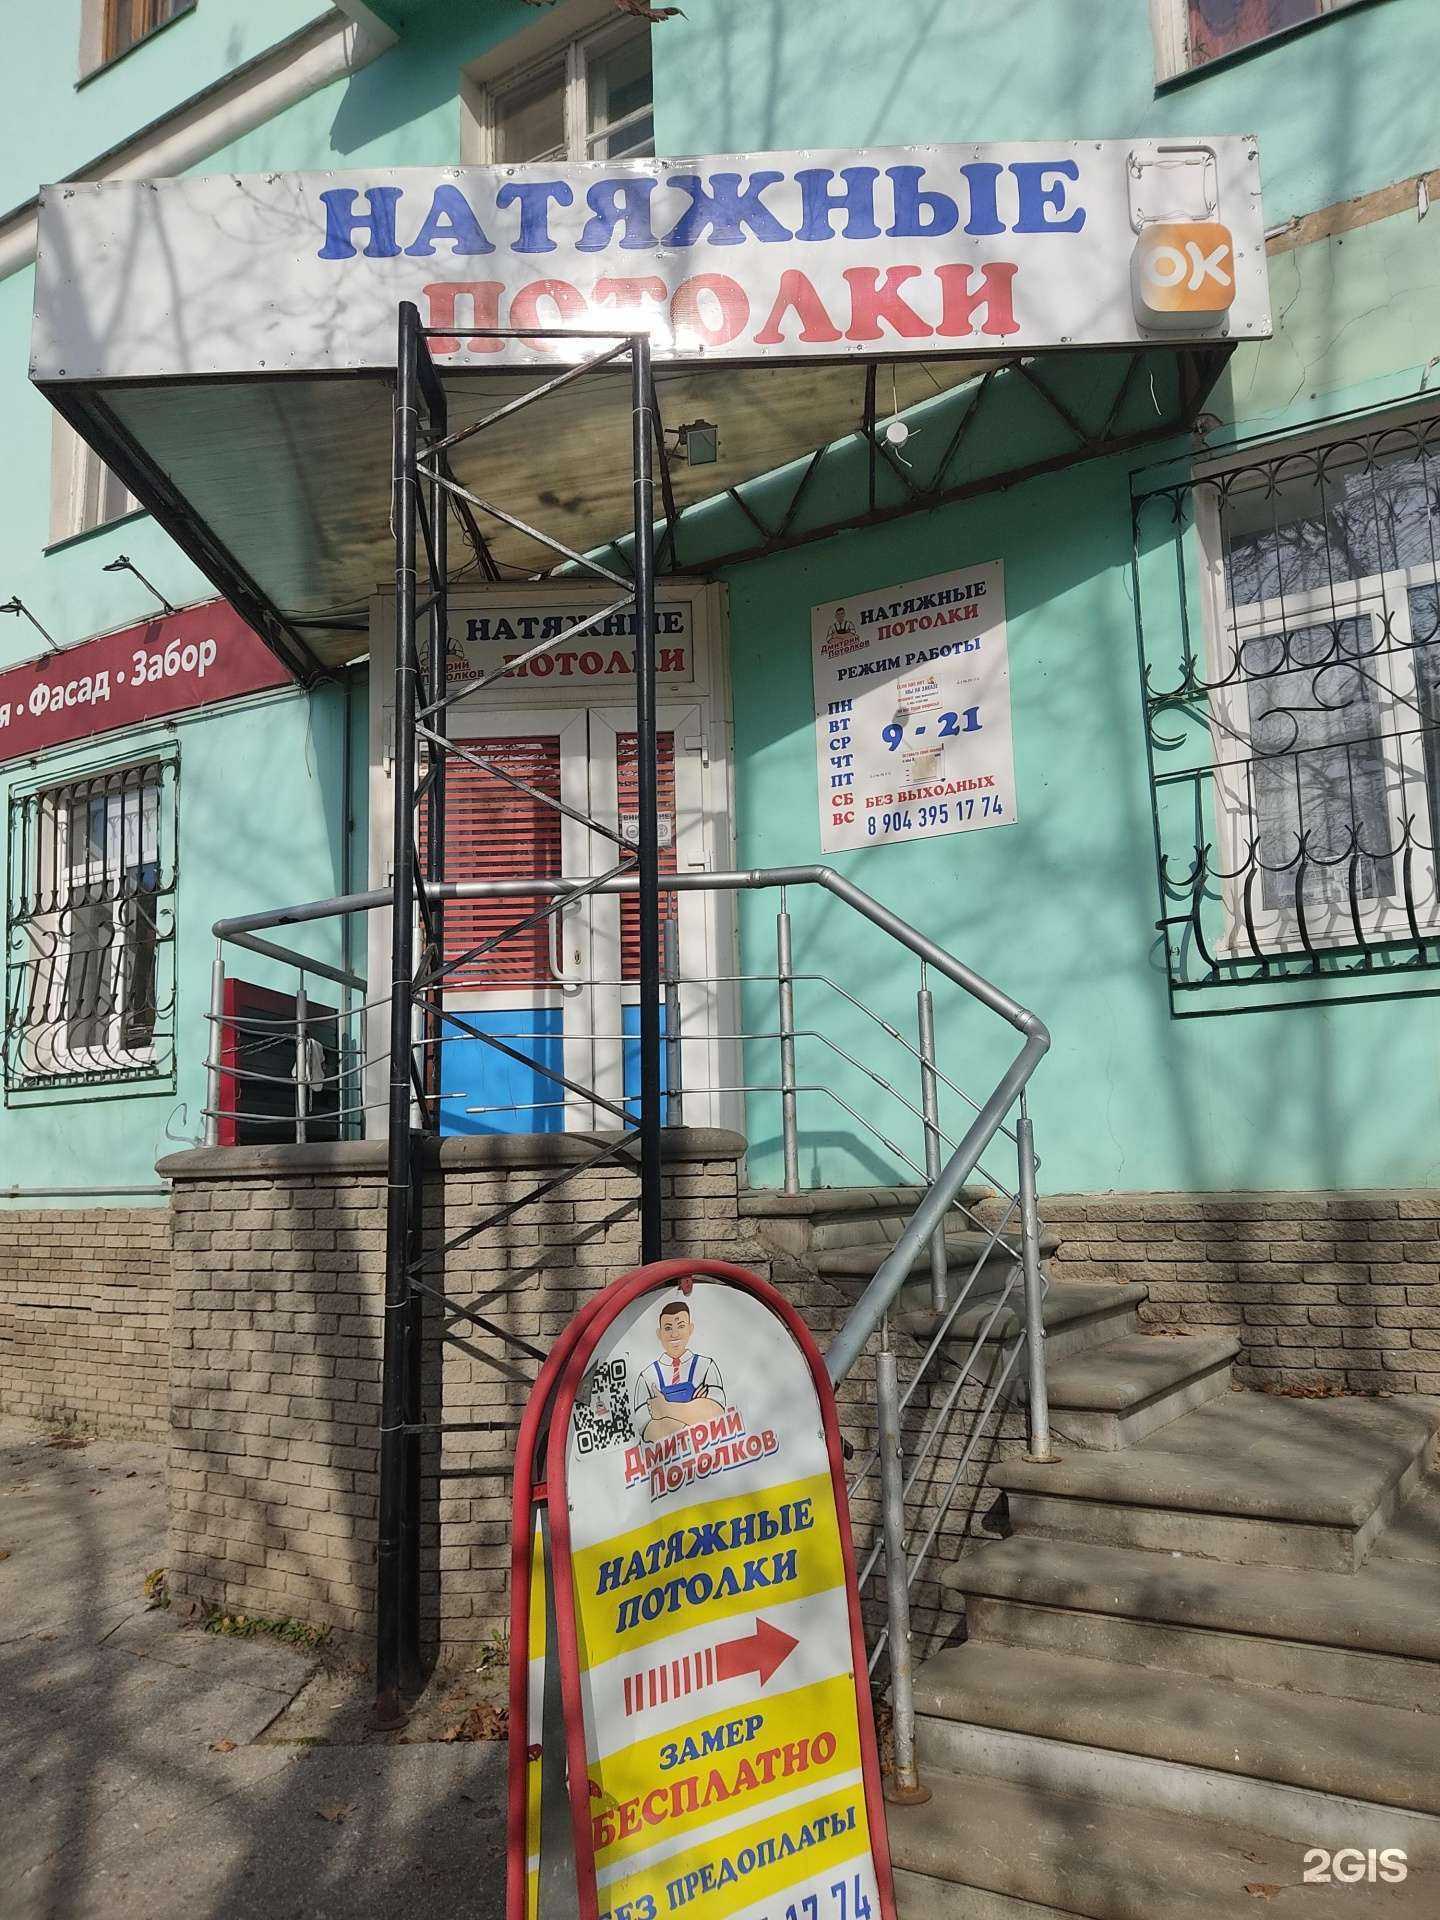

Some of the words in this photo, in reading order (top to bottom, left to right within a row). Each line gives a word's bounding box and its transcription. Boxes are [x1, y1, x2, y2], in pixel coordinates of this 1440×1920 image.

[318, 159, 1086, 260] НАТЯЖНЫЕ
[860, 581, 987, 626] НАТЯЖНЫЕ
[878, 603, 979, 641] ПОТОЛКИ
[28, 670, 111, 716] Фасад
[130, 637, 218, 687] Забор
[502, 648, 685, 678] ПОТОЛИ
[837, 655, 900, 681] РЕЖИМ
[906, 637, 981, 666] РАБОТЫ
[828, 699, 853, 716] ПН
[829, 718, 851, 733] ВТ
[829, 736, 851, 751] СР
[882, 723, 904, 752] 9
[938, 706, 983, 737] 21
[830, 754, 854, 769] ЧТ
[831, 772, 854, 788] ПТ
[831, 792, 854, 807] СБ
[865, 793, 894, 809] БЕЗ
[898, 775, 995, 804] ВЫХОДНЫХ
[833, 811, 855, 826] ВС
[868, 815, 877, 836] 8
[882, 810, 912, 834] 904
[918, 803, 949, 828] 395
[956, 799, 975, 821] 17
[981, 794, 1003, 817] 74
[596, 1497, 815, 1597] НАТЯЖНЫЕ
[615, 1549, 798, 1634] ПОТОЛКИ
[659, 1714, 764, 1770] ЗАМЕР
[593, 1731, 837, 1851] БЕСПЛАТНО
[665, 1806, 857, 1911] ПРЕДОПЛАТЫ
